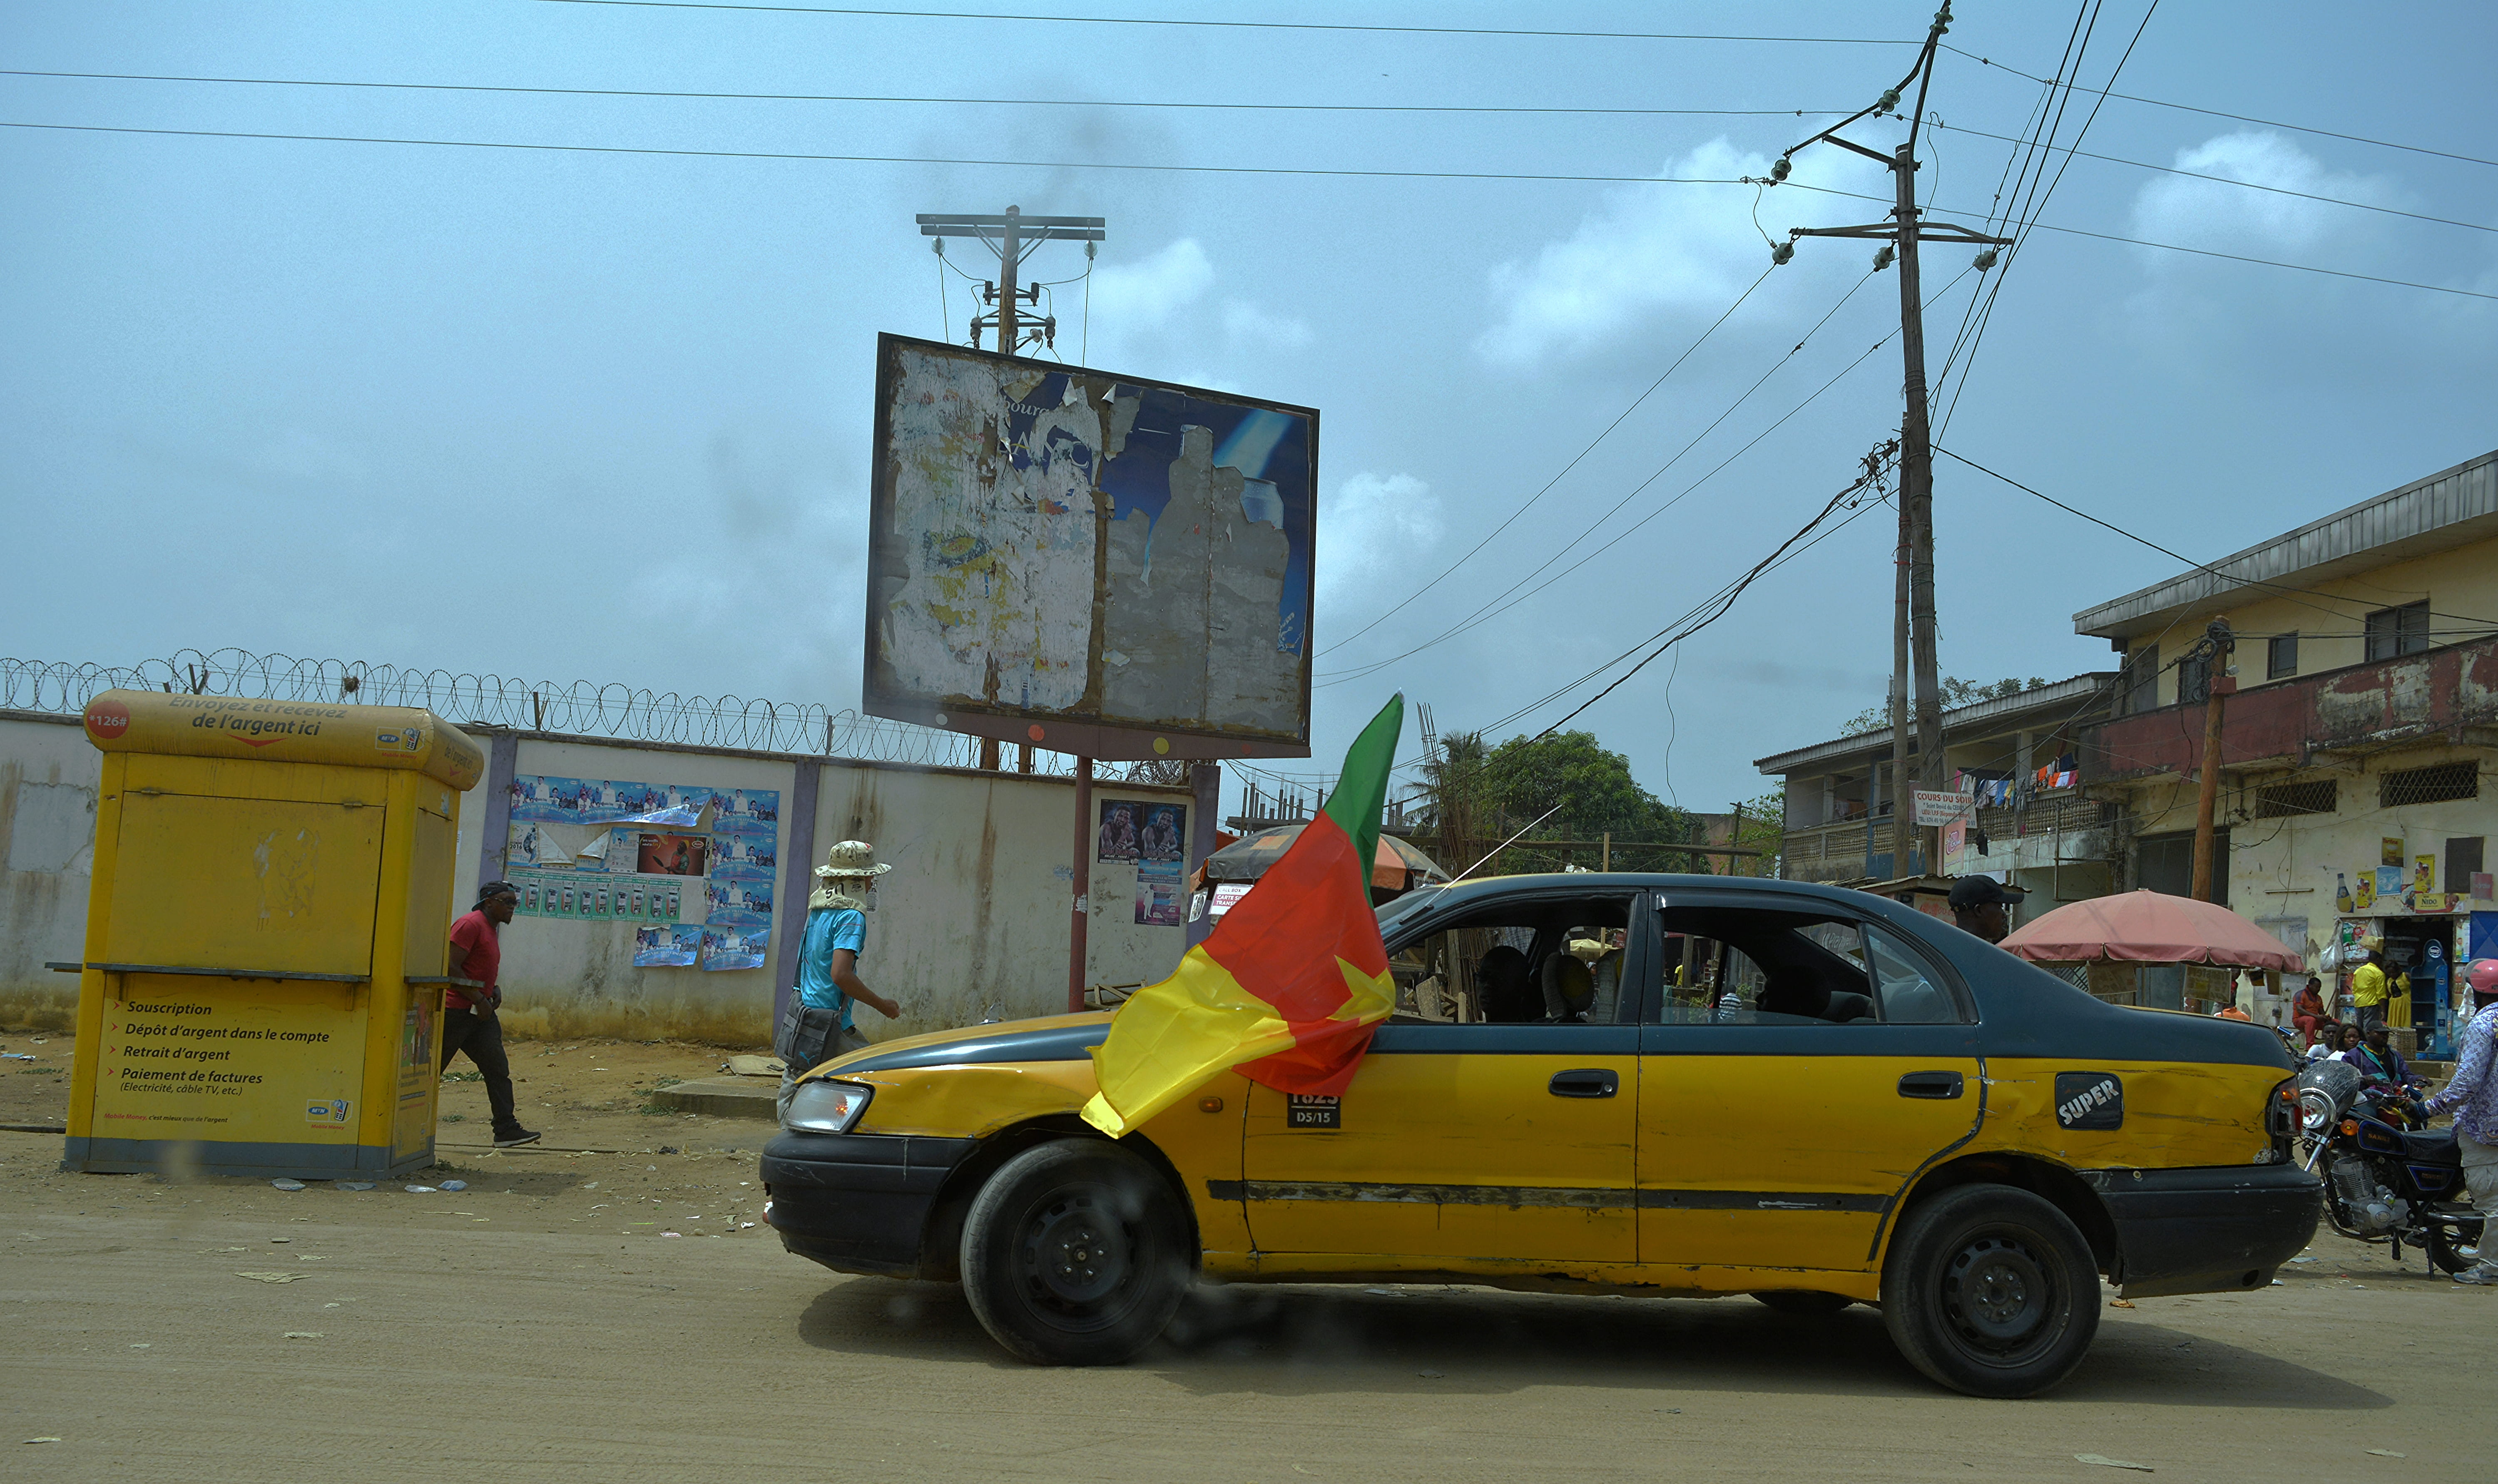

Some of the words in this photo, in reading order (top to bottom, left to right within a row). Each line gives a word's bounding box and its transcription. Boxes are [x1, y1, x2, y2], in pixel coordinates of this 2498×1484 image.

[169, 696, 249, 712] Envoyez
[253, 701, 274, 712] et
[275, 703, 348, 718] recevez
[192, 713, 216, 728] de
[219, 713, 296, 736] l'argent
[298, 721, 321, 736] ici
[1917, 793, 1941, 802] COURS
[127, 1001, 212, 1016] Souscription
[125, 1023, 167, 1038] Dépôt
[170, 1024, 228, 1040] d'argent
[230, 1027, 263, 1039] dans
[265, 1029, 277, 1040] le
[280, 1032, 329, 1044] compte
[123, 1045, 170, 1058] Retrait
[172, 1047, 230, 1062] d'argent
[121, 1068, 186, 1081] Paiement
[189, 1070, 205, 1081] de
[208, 1070, 263, 1084] factures
[120, 1082, 174, 1094] (Electricité,
[177, 1084, 203, 1094] câble
[205, 1086, 219, 1096] TV,
[221, 1086, 242, 1096] etc.)
[2059, 1080, 2119, 1125] SUPER
[1297, 1112, 1330, 1123] D5/15
